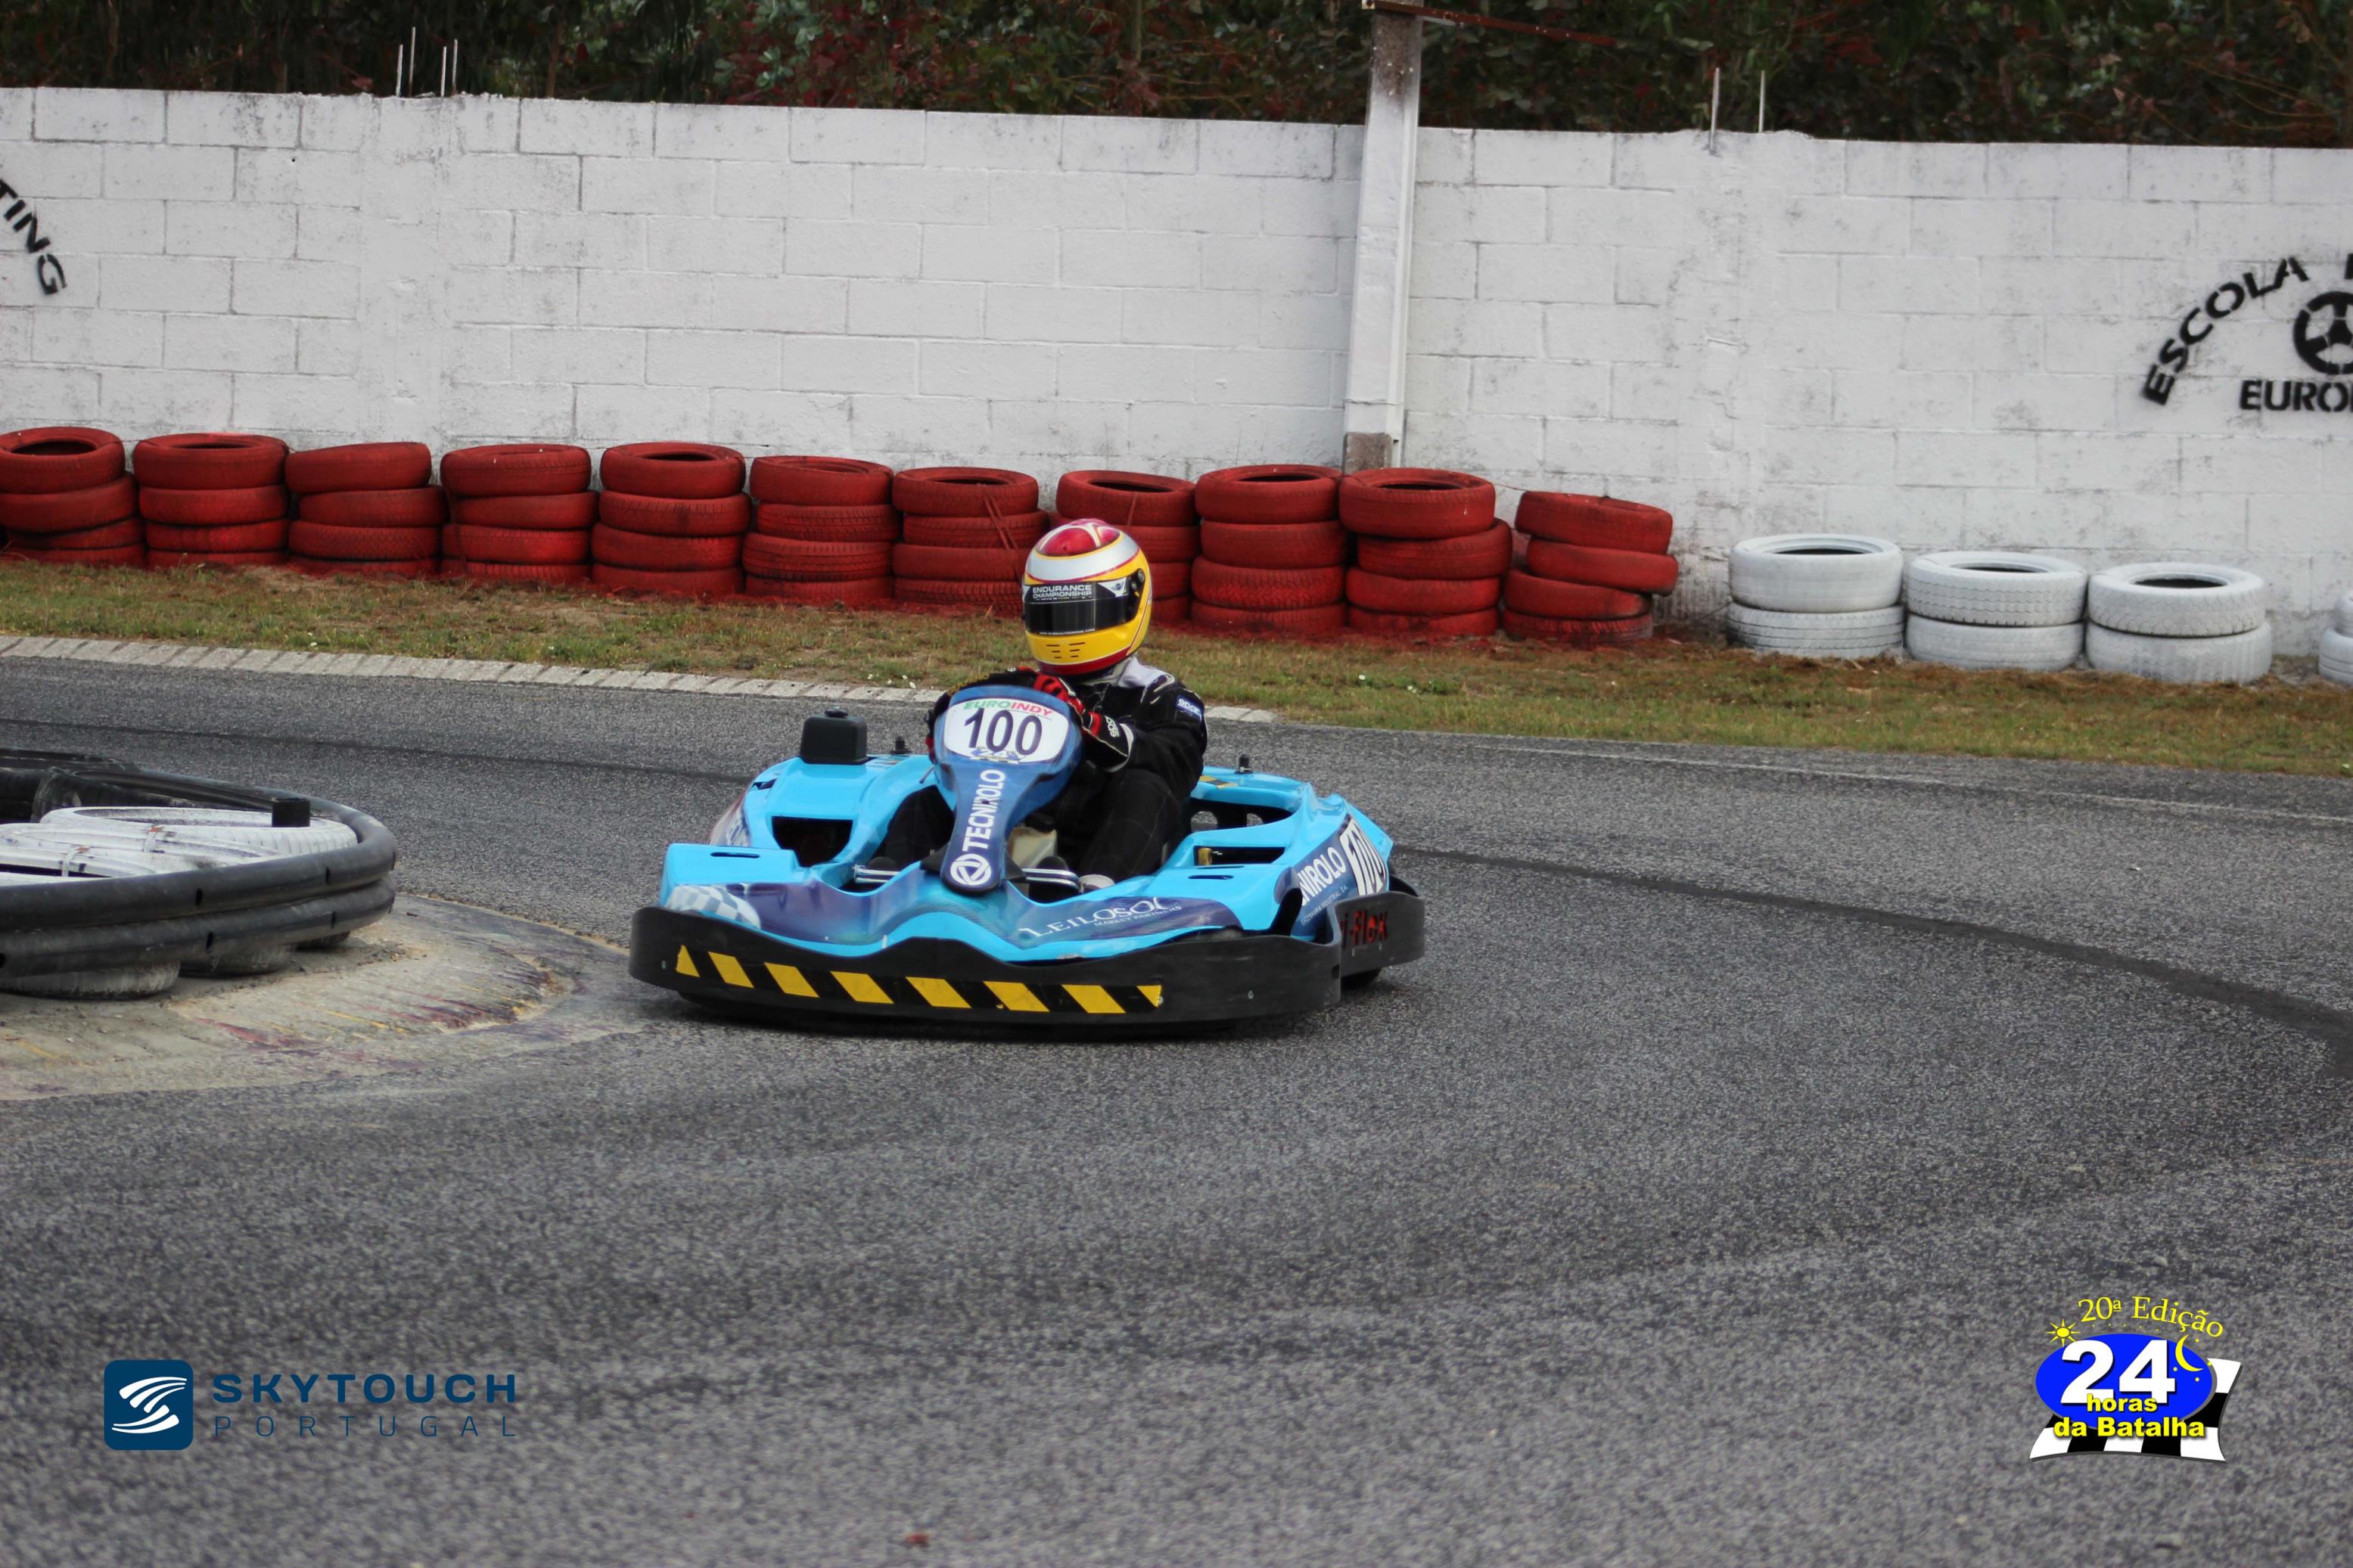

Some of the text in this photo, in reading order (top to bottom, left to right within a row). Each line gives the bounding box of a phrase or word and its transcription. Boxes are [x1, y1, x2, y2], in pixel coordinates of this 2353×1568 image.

[2143, 256, 2310, 405] ESCOLA
[1032, 584, 1092, 594] ENDURANCE
[1032, 591, 1093, 599] CHAMPIONSHIP
[963, 700, 1052, 716] EUROINDY
[964, 707, 1043, 756] 100
[962, 769, 1006, 852] TECNIROLO
[1298, 846, 1346, 906] NIROLO
[1094, 917, 1131, 926] MARKET
